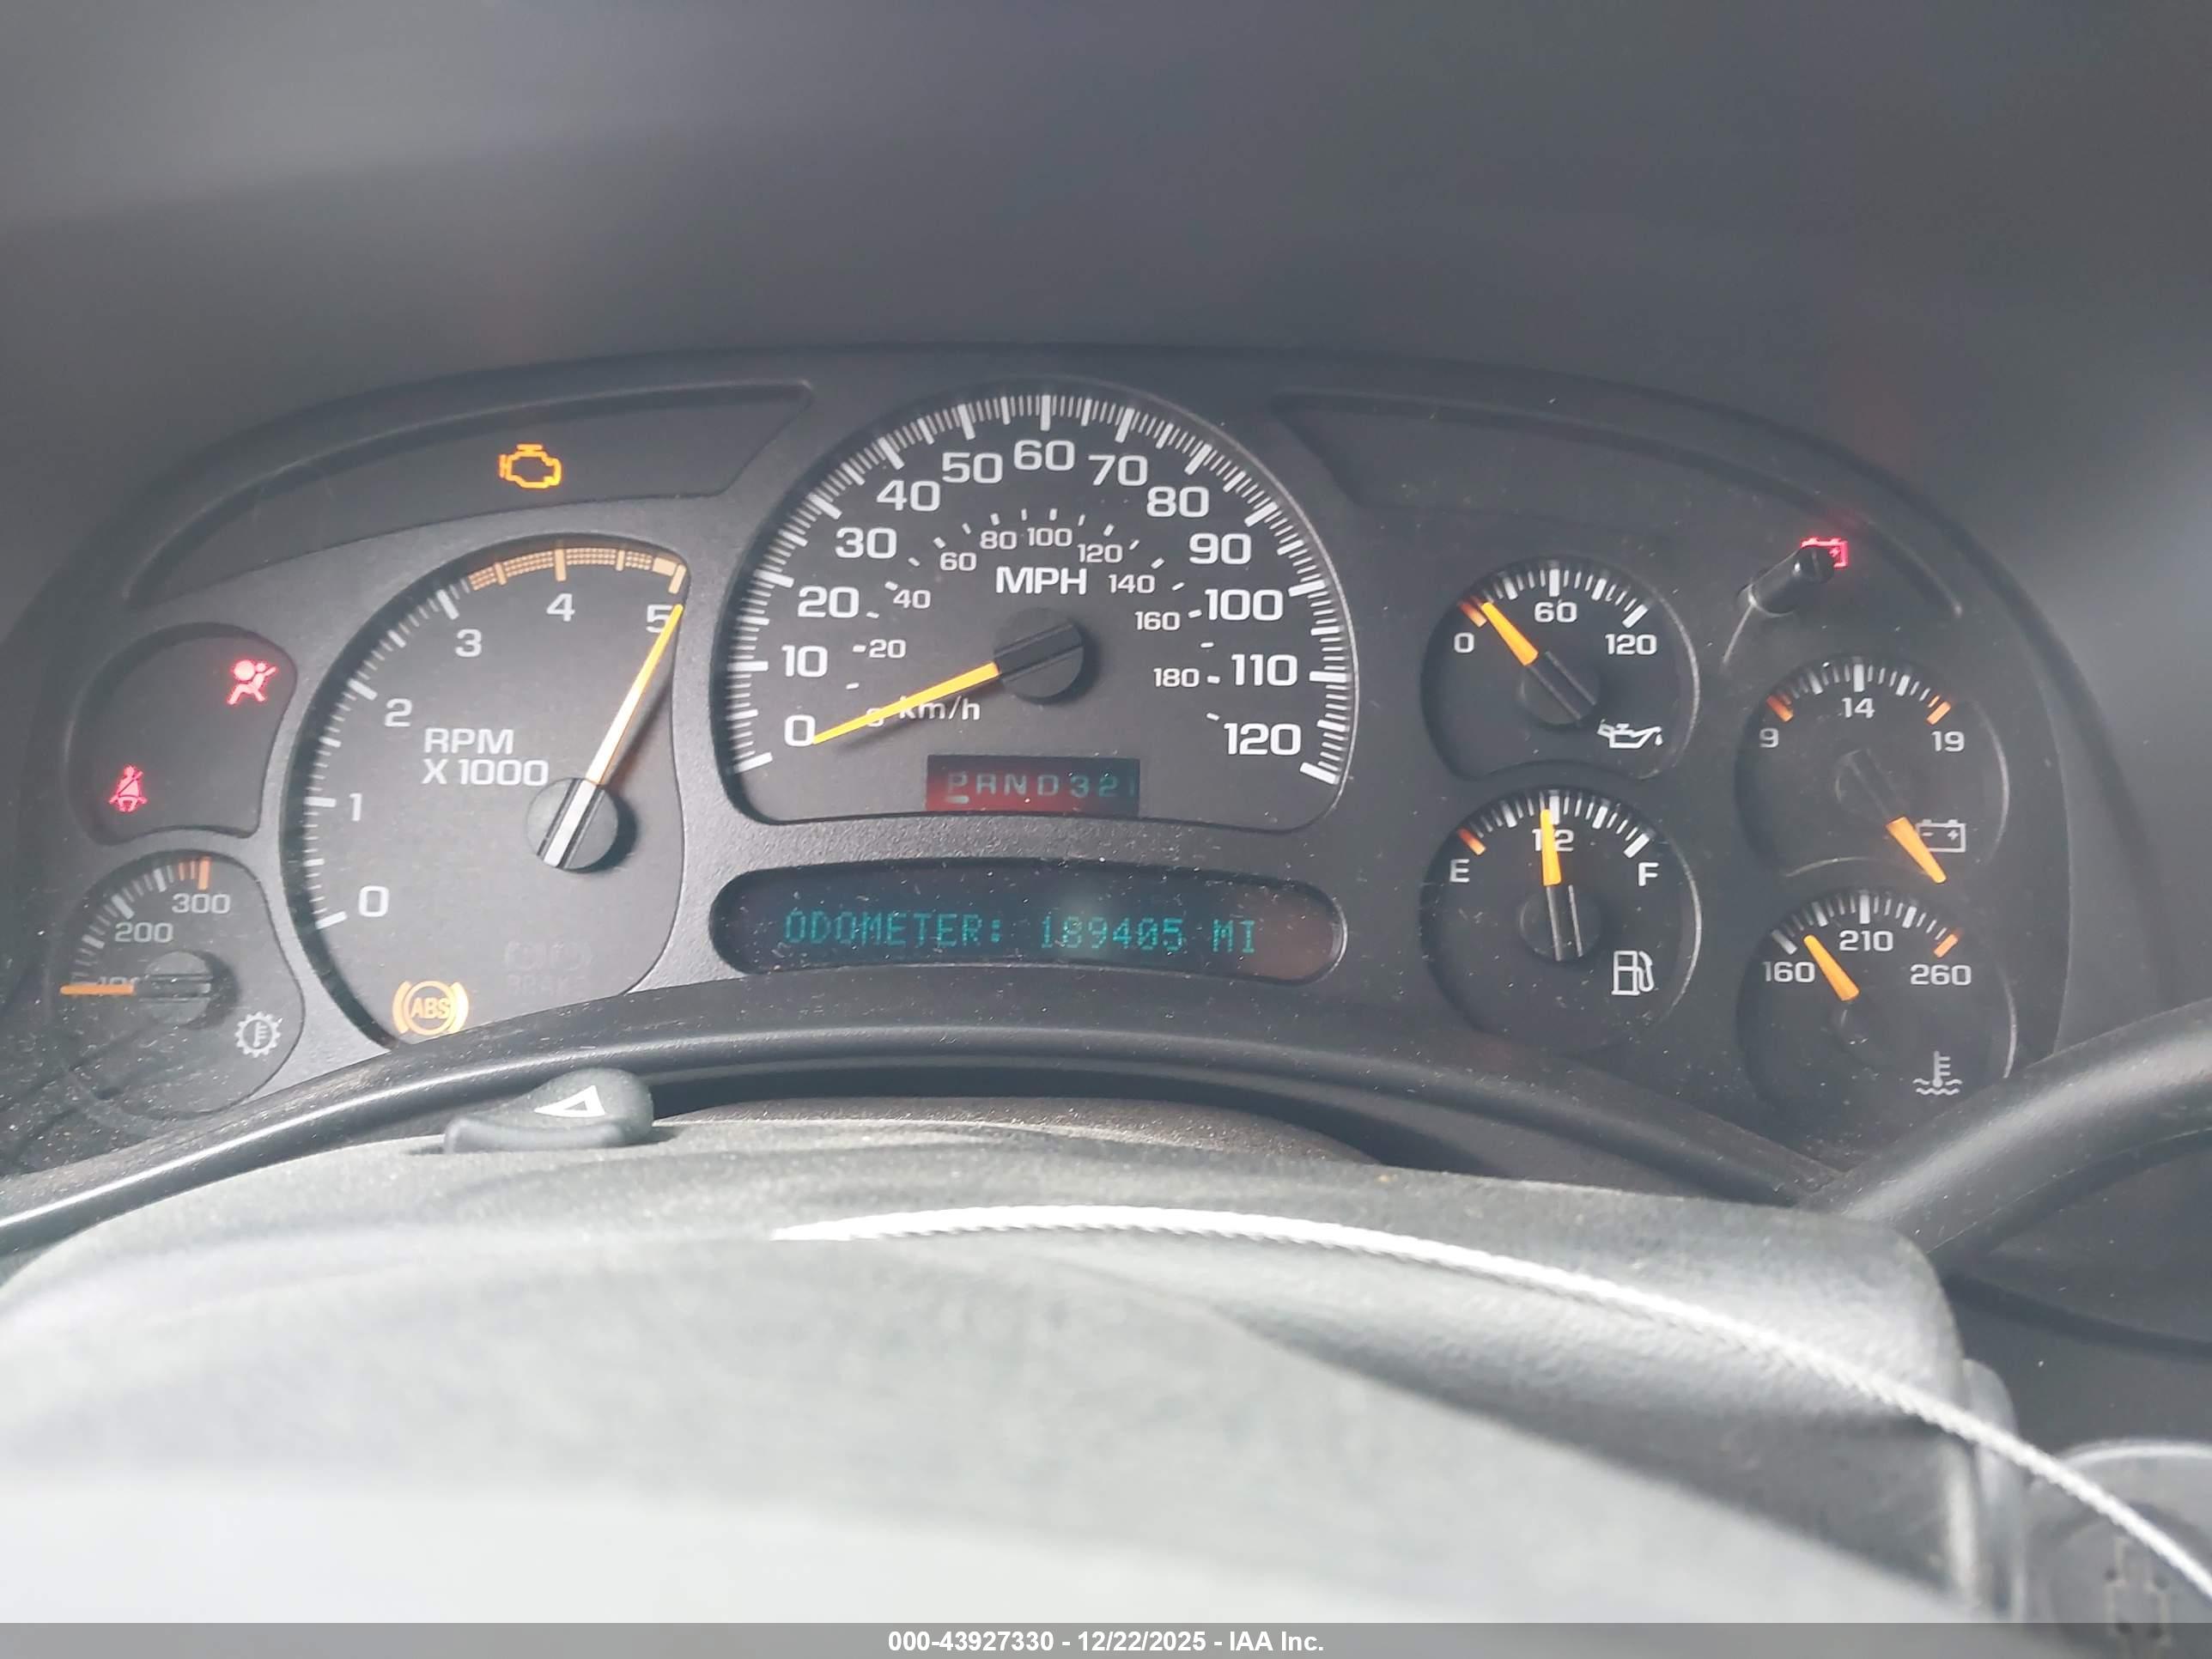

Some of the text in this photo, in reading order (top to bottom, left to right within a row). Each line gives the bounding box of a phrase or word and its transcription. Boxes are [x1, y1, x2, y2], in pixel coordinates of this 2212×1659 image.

[942, 452, 1003, 484] 50
[1013, 440, 1075, 471] 60
[1088, 453, 1148, 486] 70
[876, 480, 941, 512] 40
[1146, 486, 1210, 518] 80
[835, 527, 897, 560] 30
[980, 531, 1018, 550] 80
[1027, 527, 1073, 547] 100
[1188, 532, 1252, 565] 90
[939, 552, 977, 572] 60
[1077, 544, 1123, 563] 120
[995, 567, 1087, 595] MPH
[1108, 574, 1156, 594] 140
[546, 593, 574, 622] 4
[797, 586, 860, 618] 20
[893, 589, 931, 610] 40
[1204, 588, 1284, 621] 100
[646, 604, 674, 633] 5
[1134, 611, 1181, 631] 160
[1534, 602, 1578, 624] 60
[455, 629, 482, 657] 3
[868, 639, 907, 659] 20
[1453, 632, 1475, 653] 0
[1605, 634, 1658, 655] 120
[781, 645, 829, 678] 10
[1231, 653, 1298, 687] 110
[1153, 667, 1200, 688] 180
[385, 699, 412, 727] 2
[1841, 696, 1875, 719] 14
[424, 727, 514, 755] RPM
[784, 714, 816, 747] 0
[1223, 722, 1302, 757] 120
[1759, 727, 1779, 749] 9
[1930, 731, 1965, 753] 19
[458, 758, 549, 787] 1000
[349, 793, 362, 822] 1
[1449, 860, 1470, 883] E
[1638, 862, 1659, 886] F
[171, 893, 231, 914] 300
[359, 885, 389, 917] 0
[114, 921, 173, 943] 200
[785, 910, 1256, 954] ODOMETER: 189405 MI
[1838, 931, 1893, 952] 210
[1763, 961, 1815, 983] 160
[1910, 964, 1972, 986] 260
[411, 997, 451, 1019] ABS
